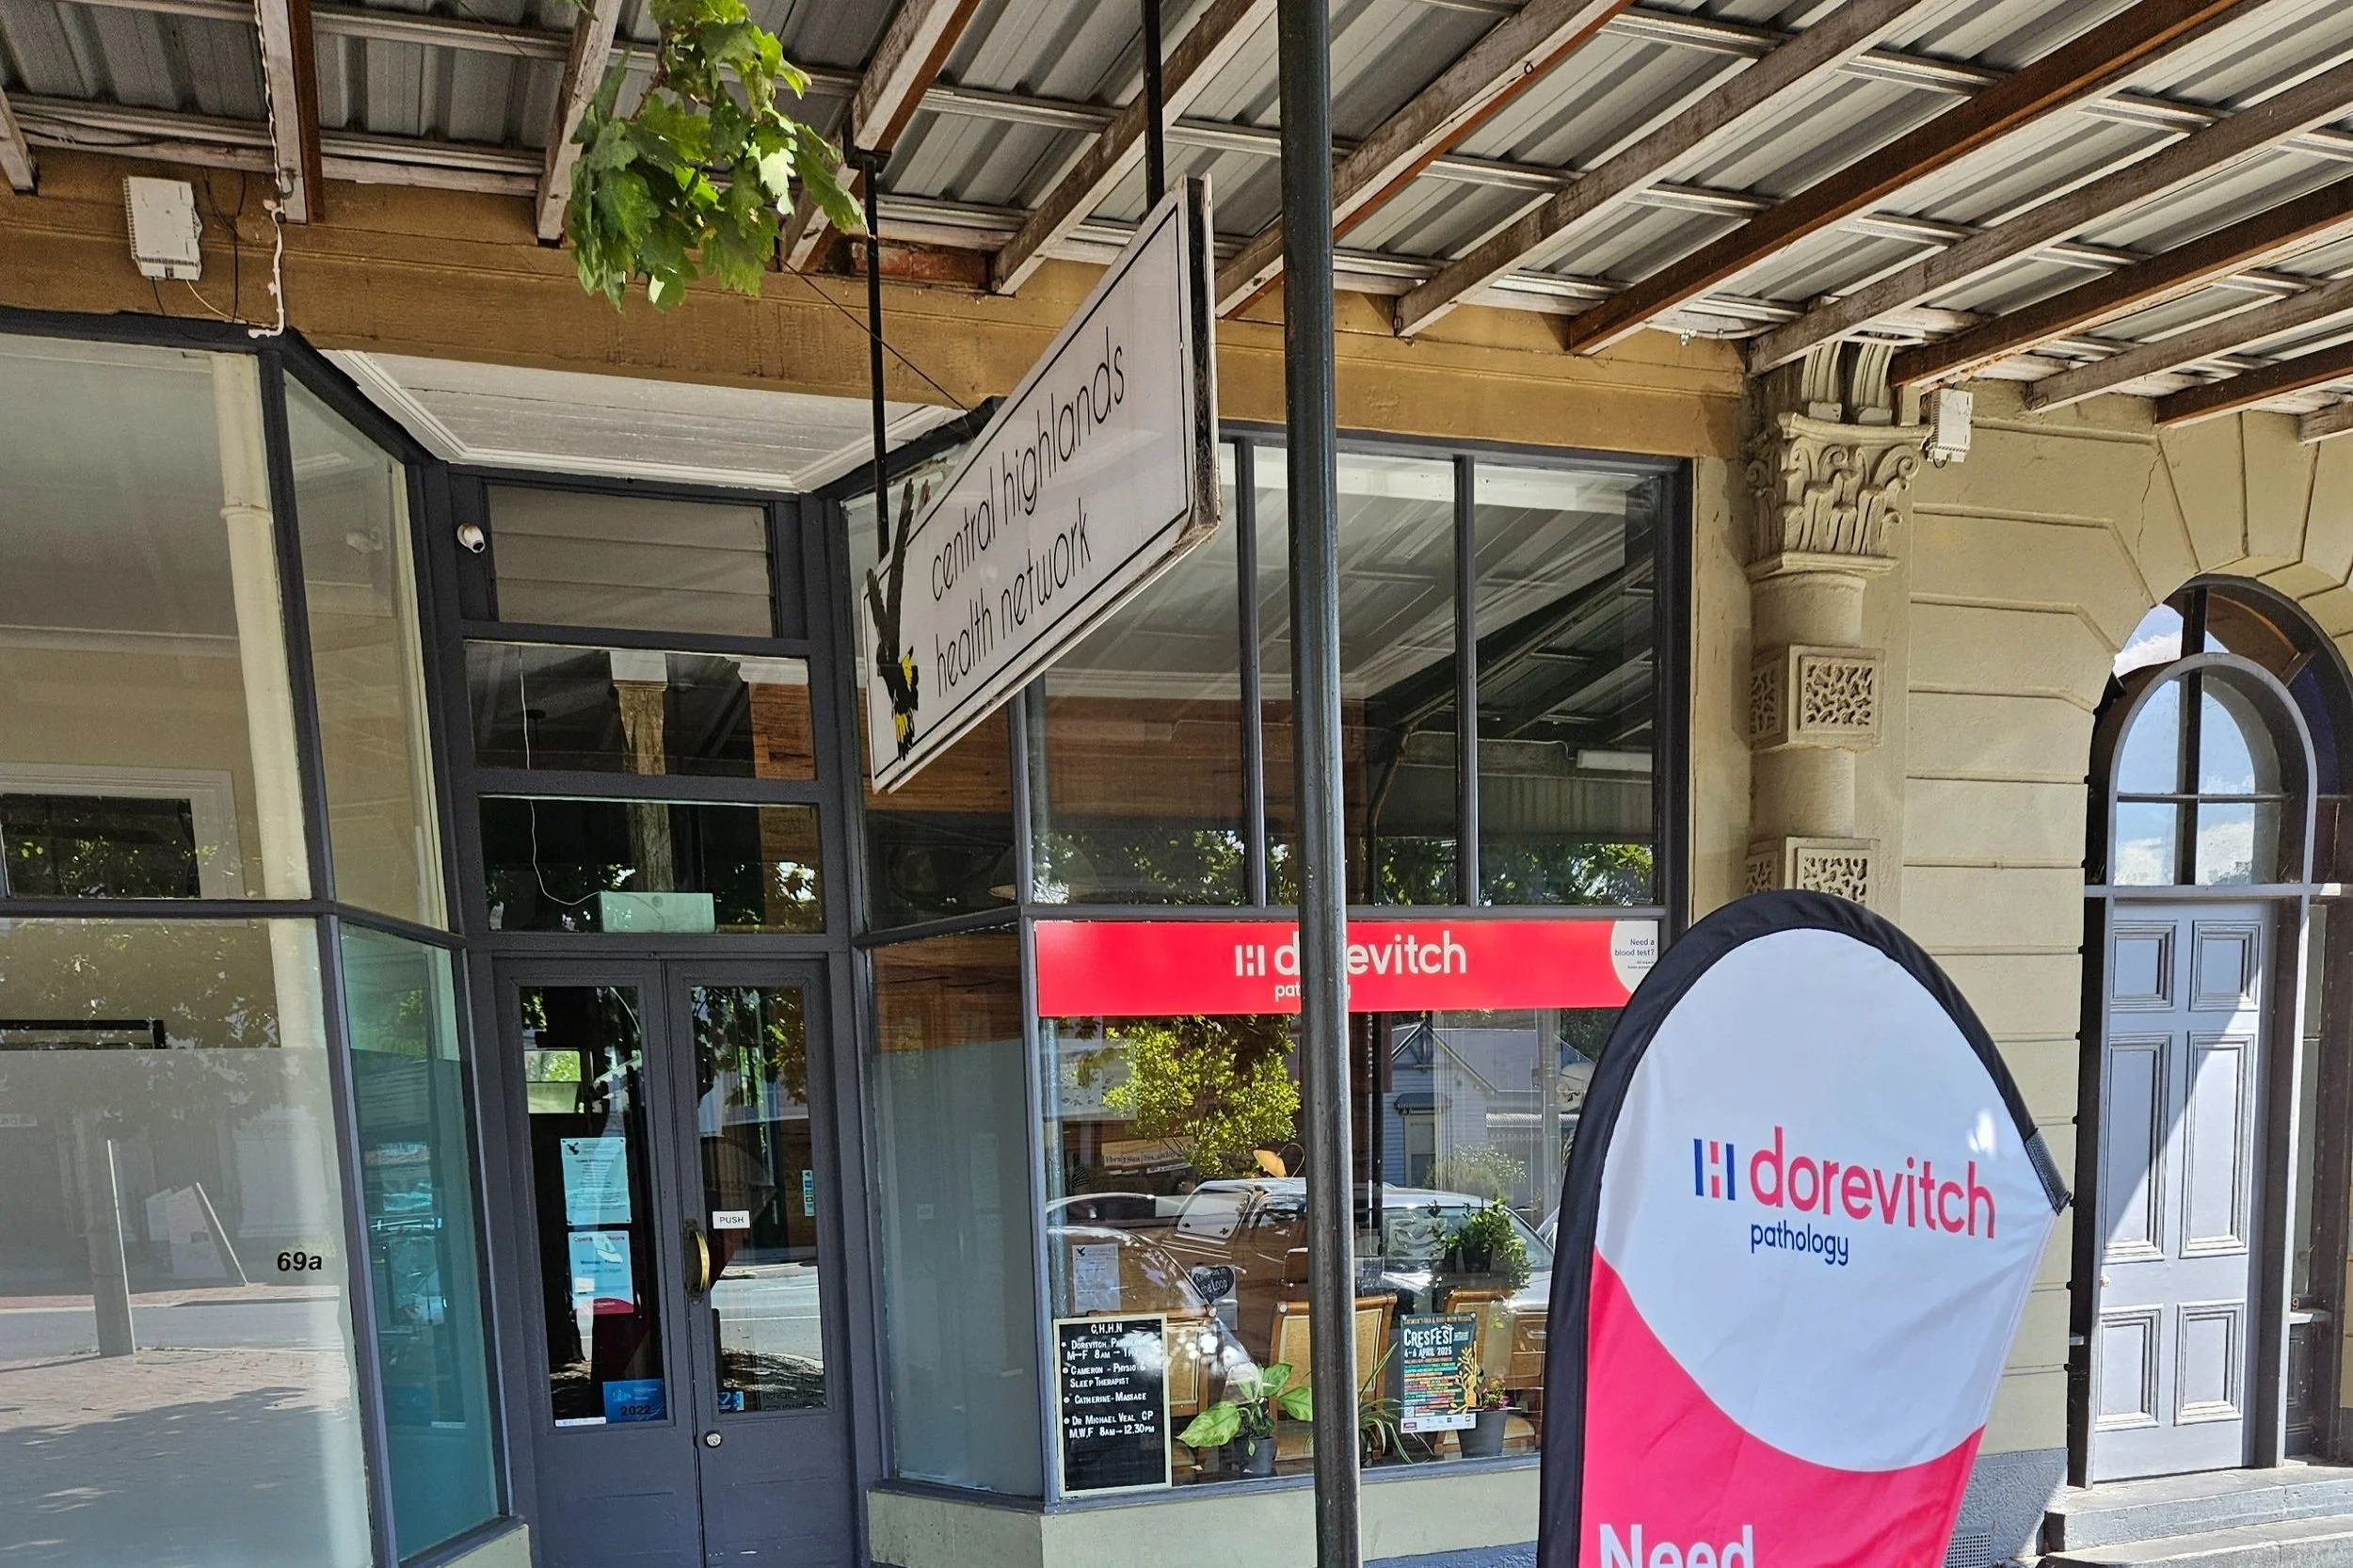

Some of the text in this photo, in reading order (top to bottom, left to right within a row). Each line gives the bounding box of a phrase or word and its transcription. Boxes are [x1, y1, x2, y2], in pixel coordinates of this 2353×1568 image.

[931, 326, 1125, 601] central highlands
[935, 497, 1092, 697] health network
[1273, 930, 1467, 976] devitch
[1629, 937, 1649, 946] Need
[1750, 1126, 1995, 1239] dorevitch
[278, 1252, 322, 1272] 69a
[1751, 1220, 1849, 1266] pathology
[620, 1404, 651, 1416] 2022
[1599, 1523, 1753, 1568] Need
